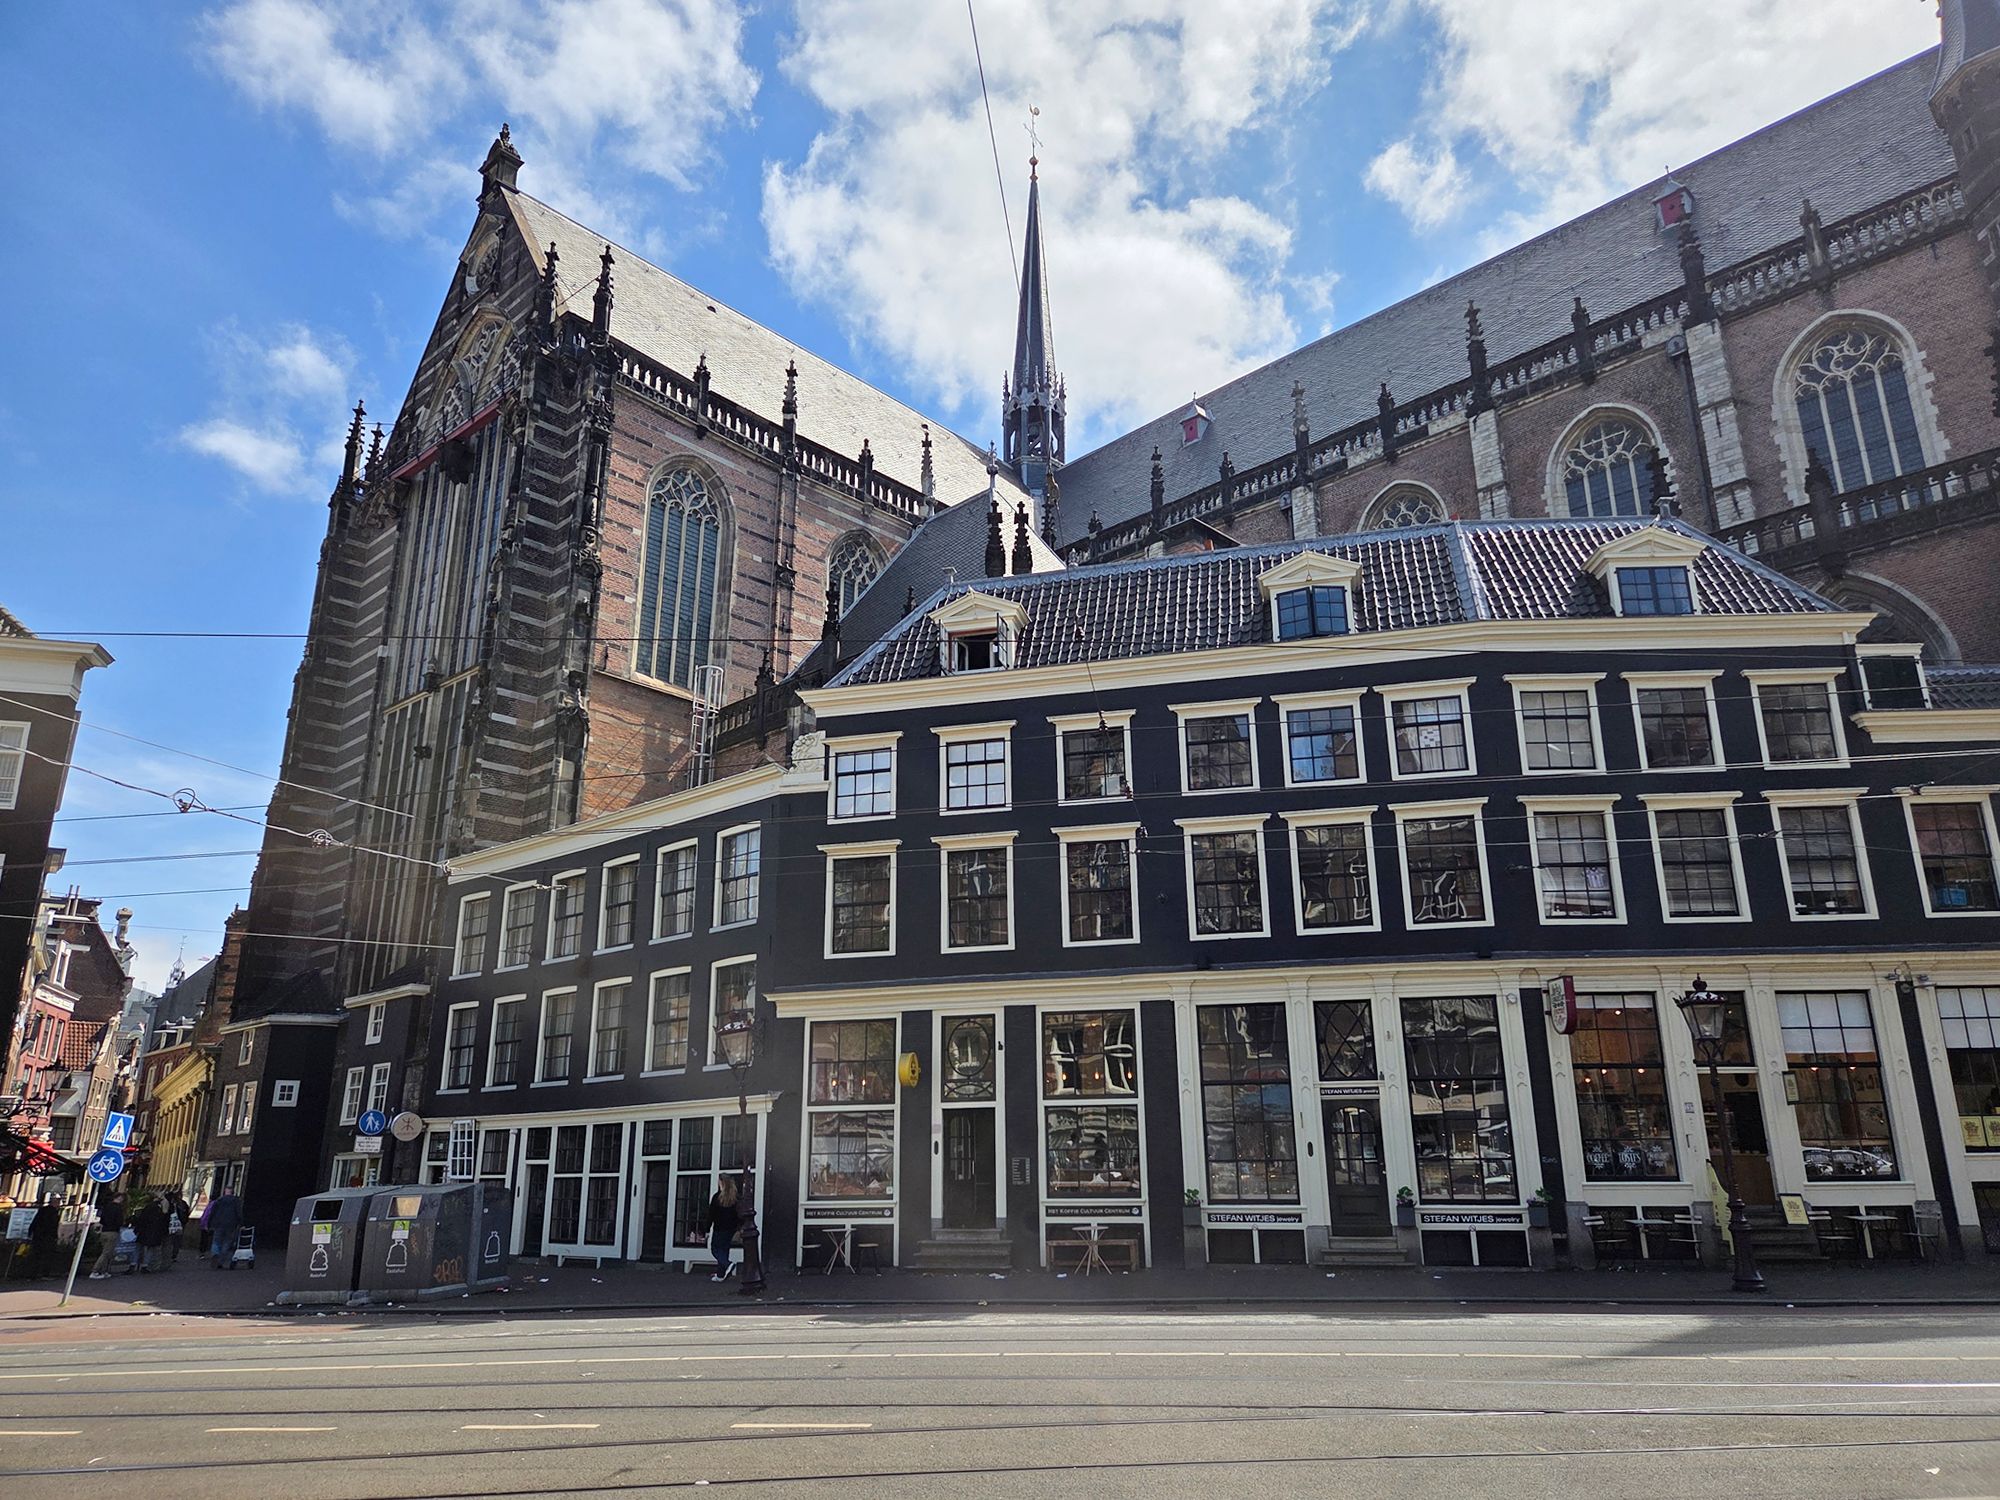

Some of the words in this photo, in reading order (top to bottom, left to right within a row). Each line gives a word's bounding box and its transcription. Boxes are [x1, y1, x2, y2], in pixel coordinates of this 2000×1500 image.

[1210, 1214, 1242, 1222] STEFAN
[1244, 1214, 1275, 1222] WITJES
[1423, 1214, 1460, 1223] STEFAN
[1460, 1214, 1494, 1223] WITJES
